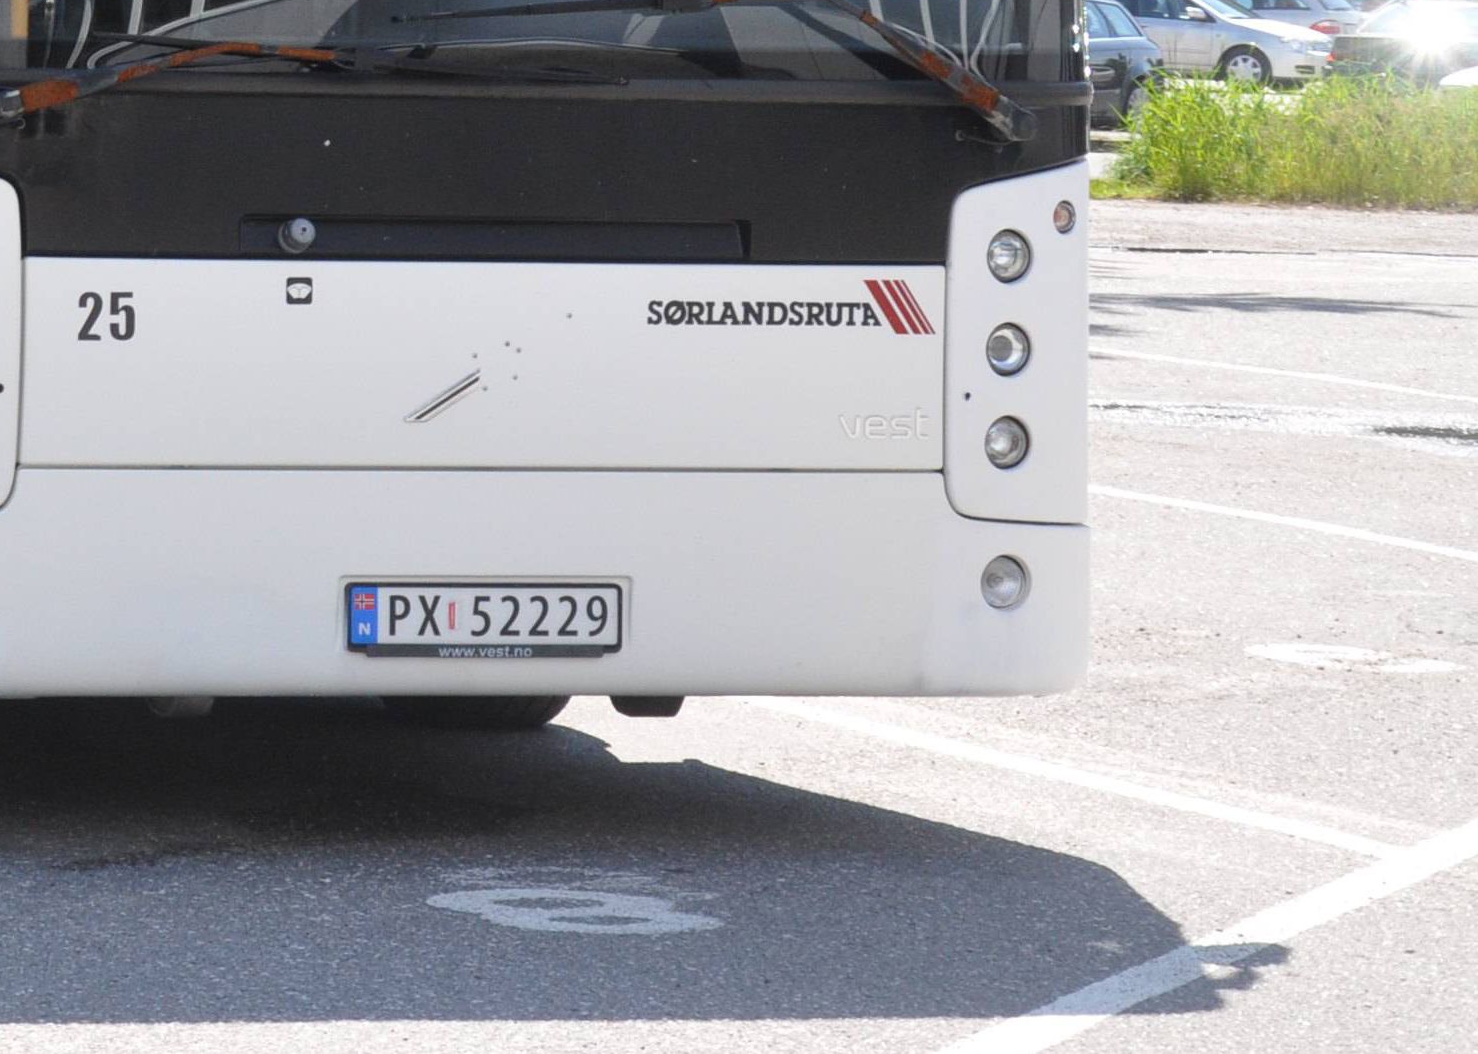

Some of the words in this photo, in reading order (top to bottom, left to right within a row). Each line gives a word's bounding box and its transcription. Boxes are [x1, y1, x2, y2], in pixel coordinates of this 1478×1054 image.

[77, 291, 136, 341] 25
[647, 300, 882, 327] SØRLANDSRUTA
[839, 406, 929, 439] vest
[358, 621, 371, 636] N
[388, 595, 441, 636] PX
[470, 595, 609, 637] 52229
[438, 646, 533, 658] www.vest.no
